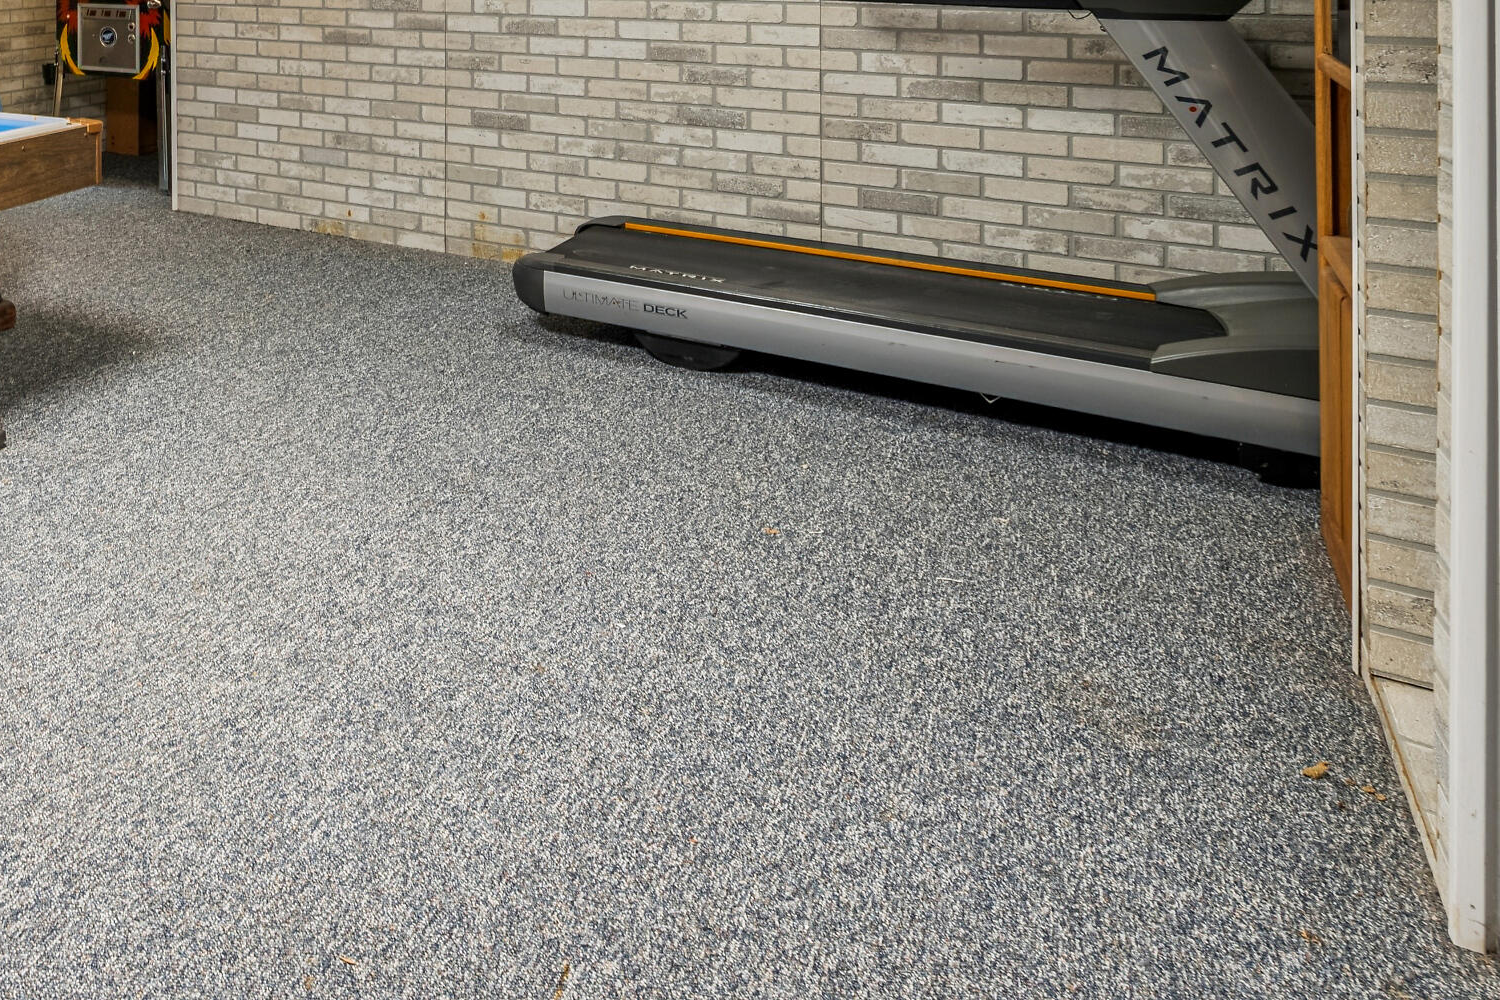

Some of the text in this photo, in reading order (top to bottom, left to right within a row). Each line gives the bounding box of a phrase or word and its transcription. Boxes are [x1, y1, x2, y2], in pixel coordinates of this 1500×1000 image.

[1141, 45, 1318, 263] MATRIX
[562, 287, 689, 320] ULTIMATE DECK
